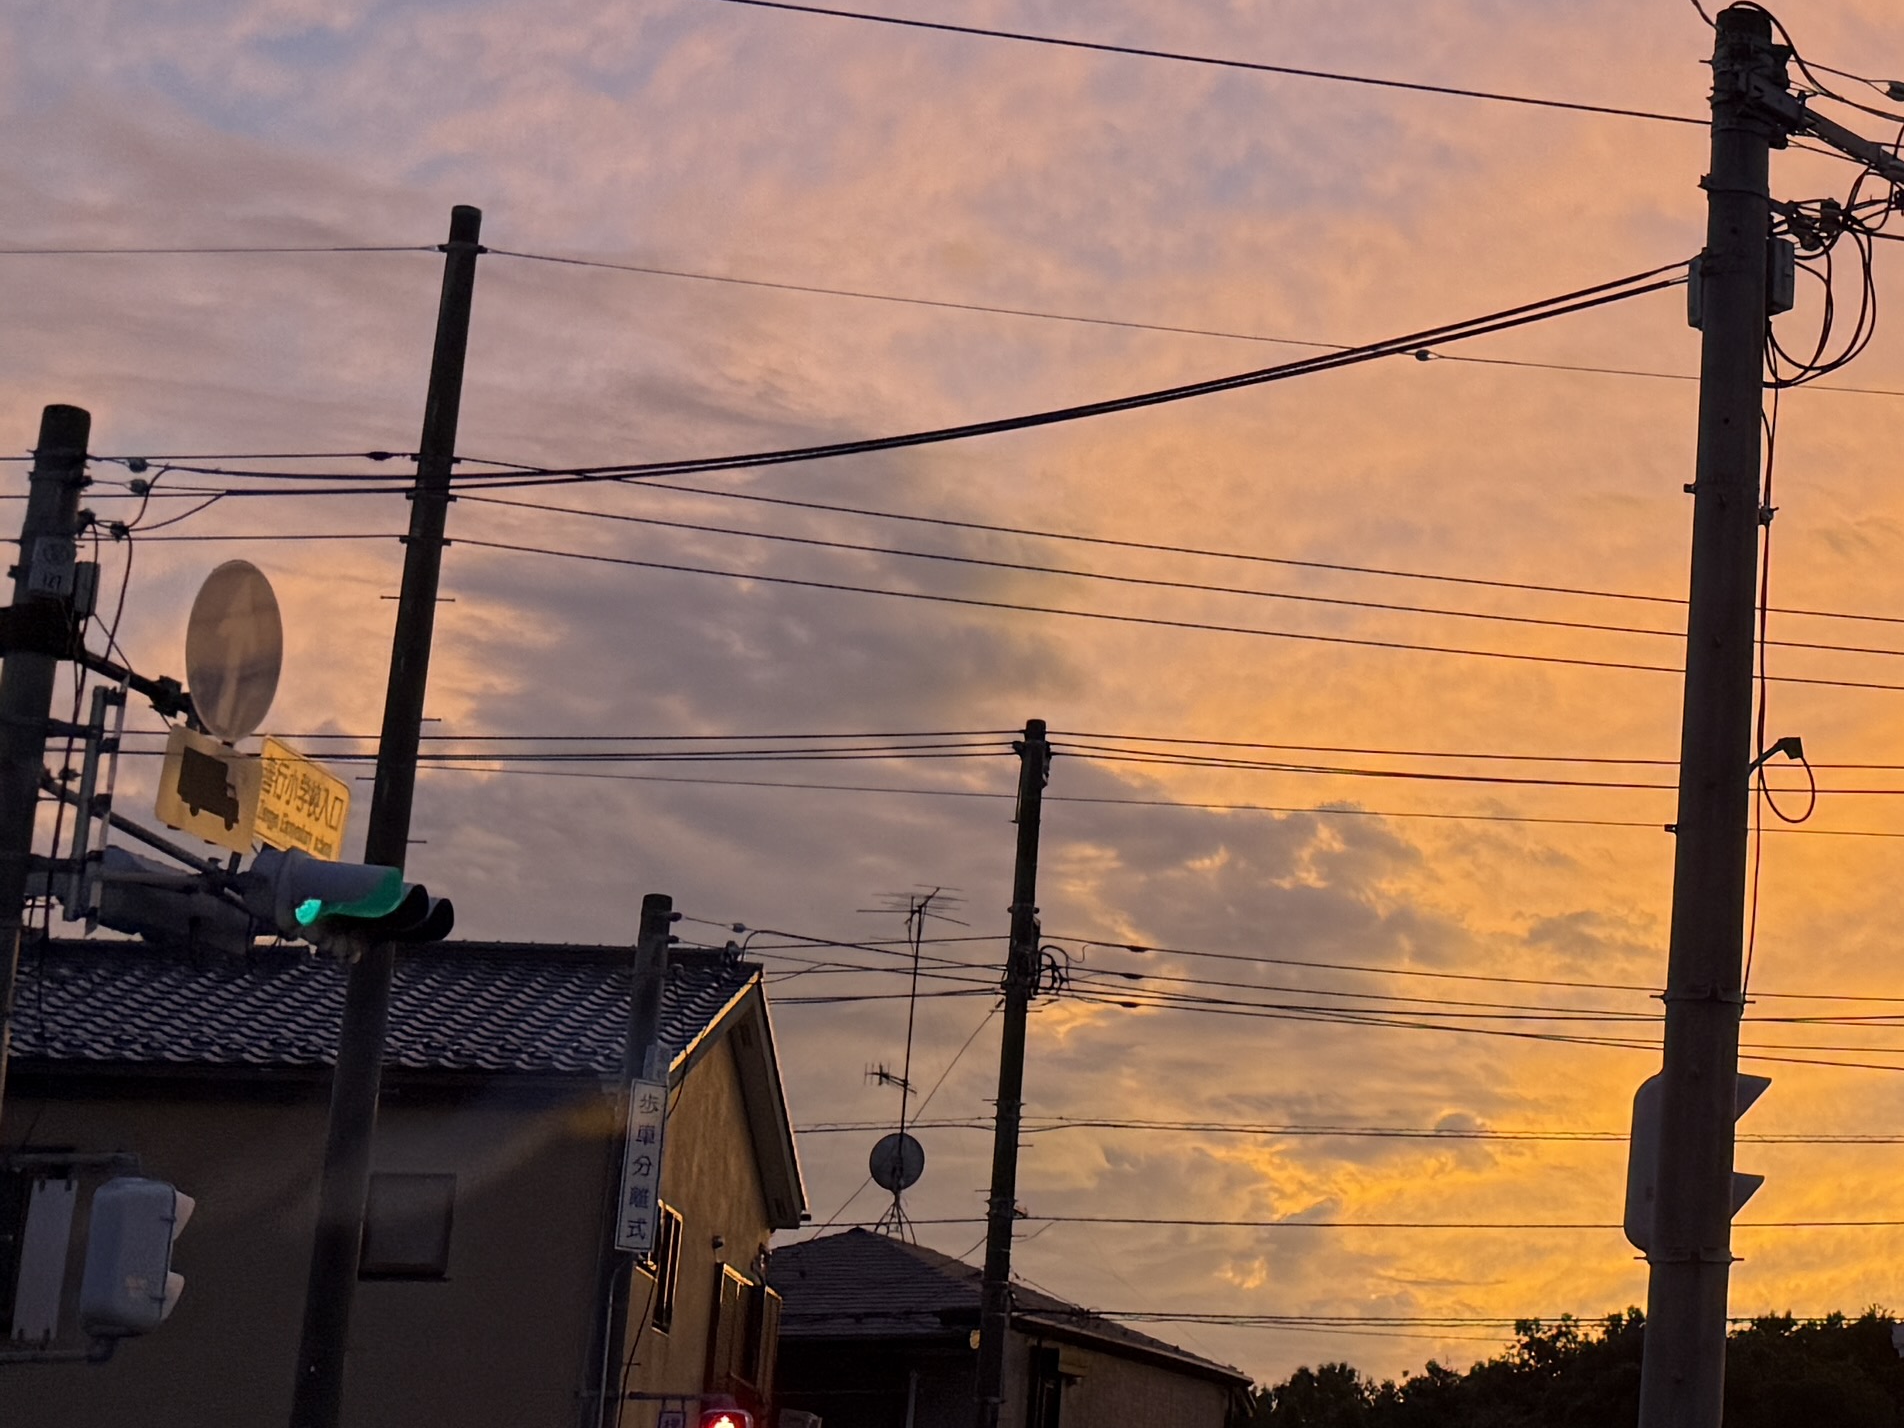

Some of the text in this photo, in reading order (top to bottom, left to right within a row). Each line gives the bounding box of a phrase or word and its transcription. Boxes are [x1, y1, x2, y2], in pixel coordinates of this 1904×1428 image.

[626, 1093, 660, 1240] 歩車分離式
